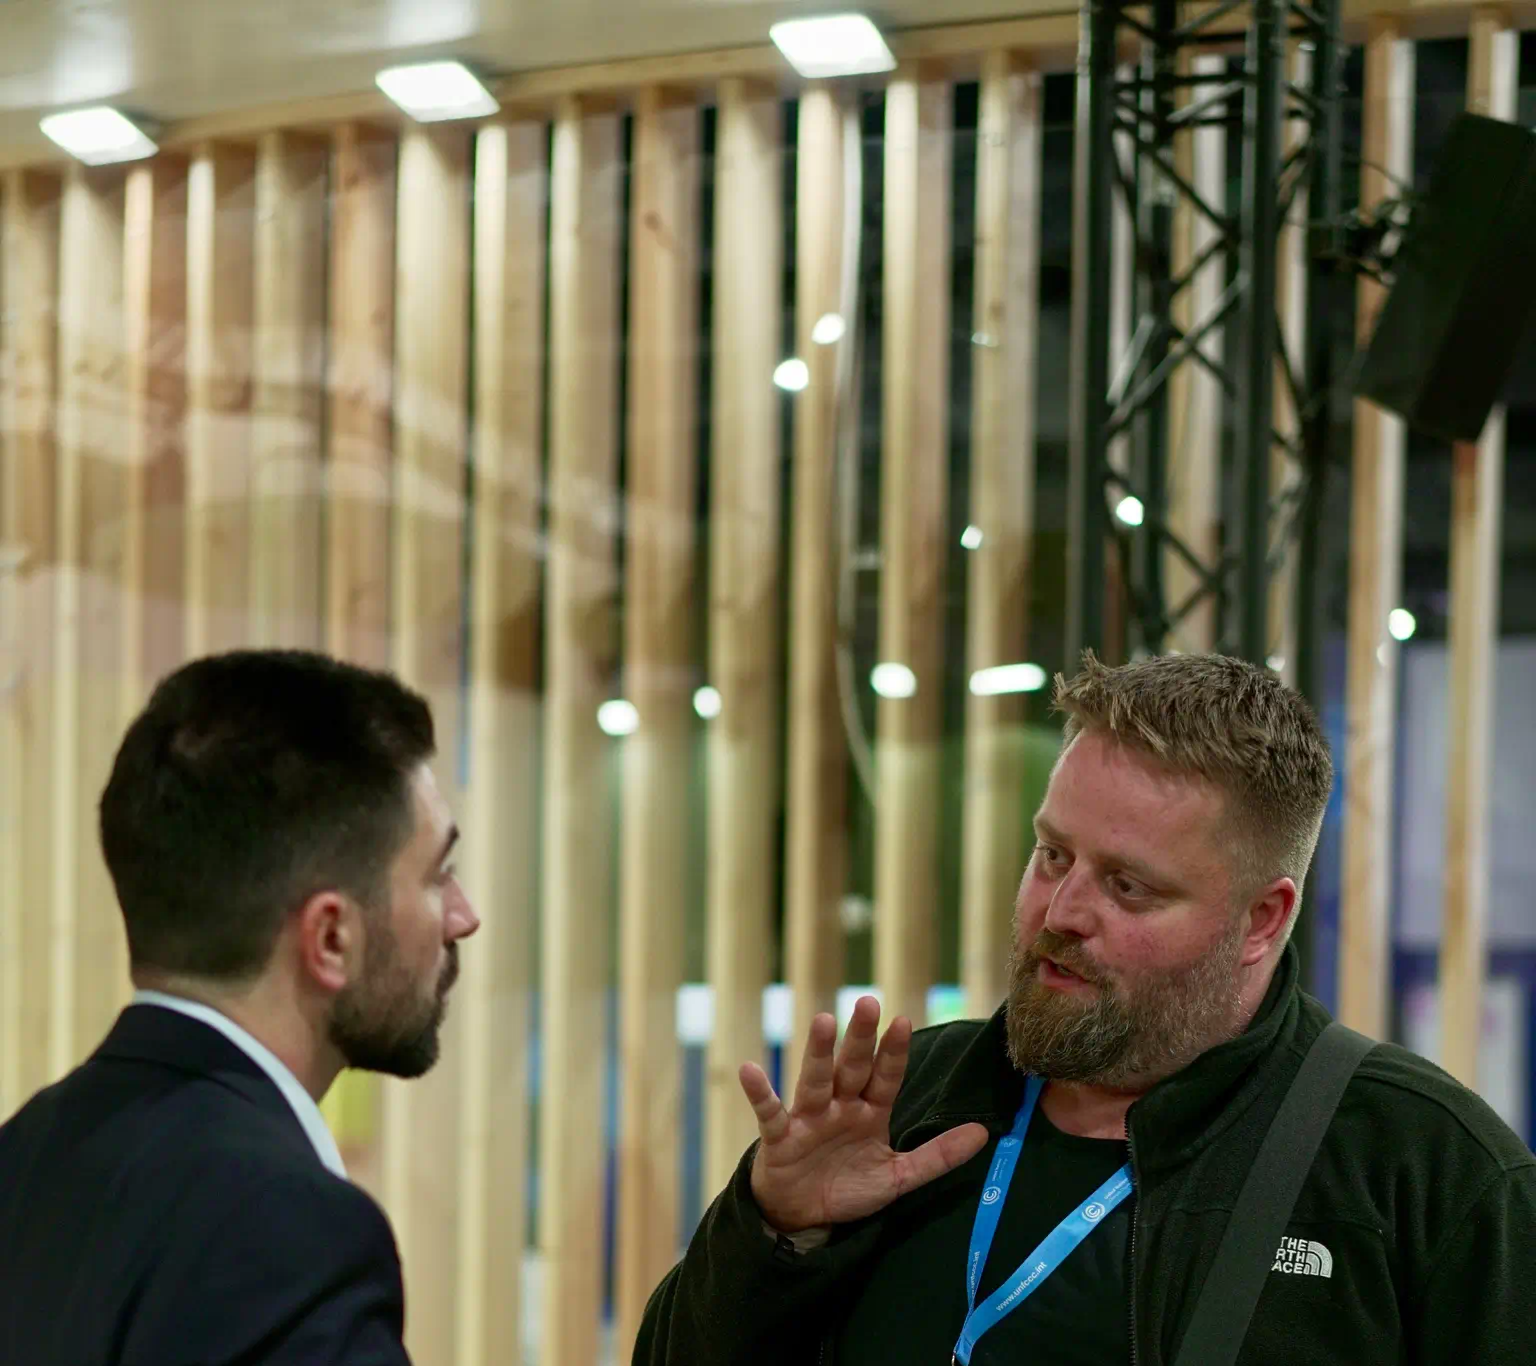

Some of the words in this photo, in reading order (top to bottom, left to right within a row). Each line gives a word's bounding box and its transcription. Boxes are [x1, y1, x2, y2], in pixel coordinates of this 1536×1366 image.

[1280, 1236, 1308, 1252] THE
[1275, 1248, 1306, 1263] RTH
[1271, 1260, 1304, 1274] ACE
[996, 1261, 1047, 1311] www.unfccc.int
